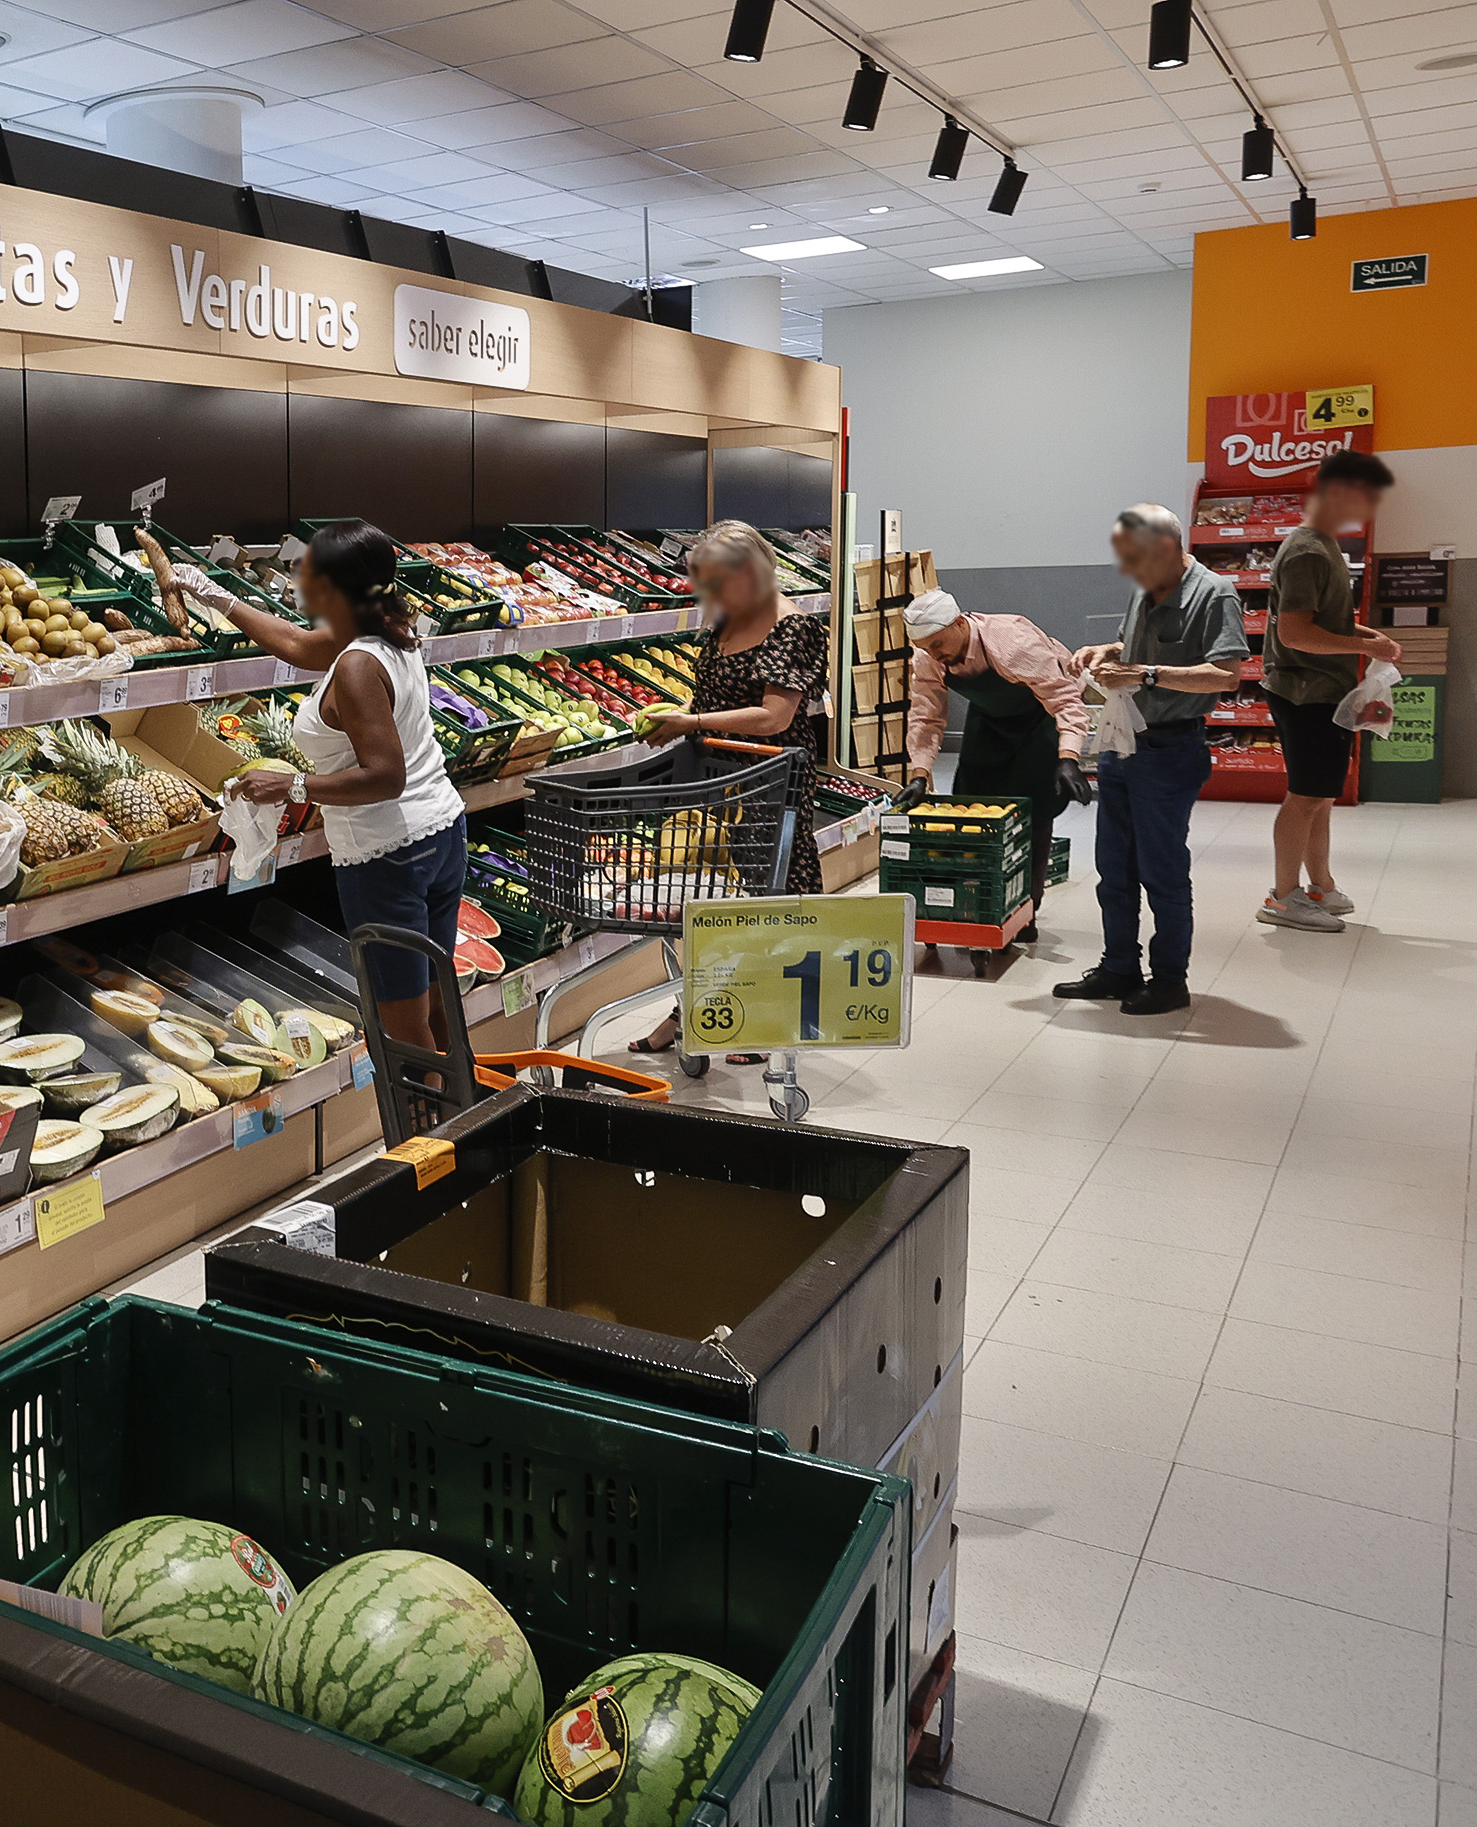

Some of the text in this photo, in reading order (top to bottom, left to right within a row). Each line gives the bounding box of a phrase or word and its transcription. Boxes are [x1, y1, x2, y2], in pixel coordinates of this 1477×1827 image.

[1360, 260, 1418, 276] SALIDA
[105, 255, 134, 323] y
[169, 244, 361, 351] Verduras
[407, 316, 520, 374] saber elegir
[1312, 395, 1355, 422] 4 99
[1220, 431, 1353, 466] Dulcesol
[114, 687, 122, 703] 6
[692, 914, 818, 928] Melón Piel de Sapo
[704, 996, 732, 1007] TECLA
[783, 949, 892, 1041] 1 19
[700, 1007, 734, 1030] 33
[845, 1004, 890, 1025] €/Kg
[15, 1214, 22, 1233] 1
